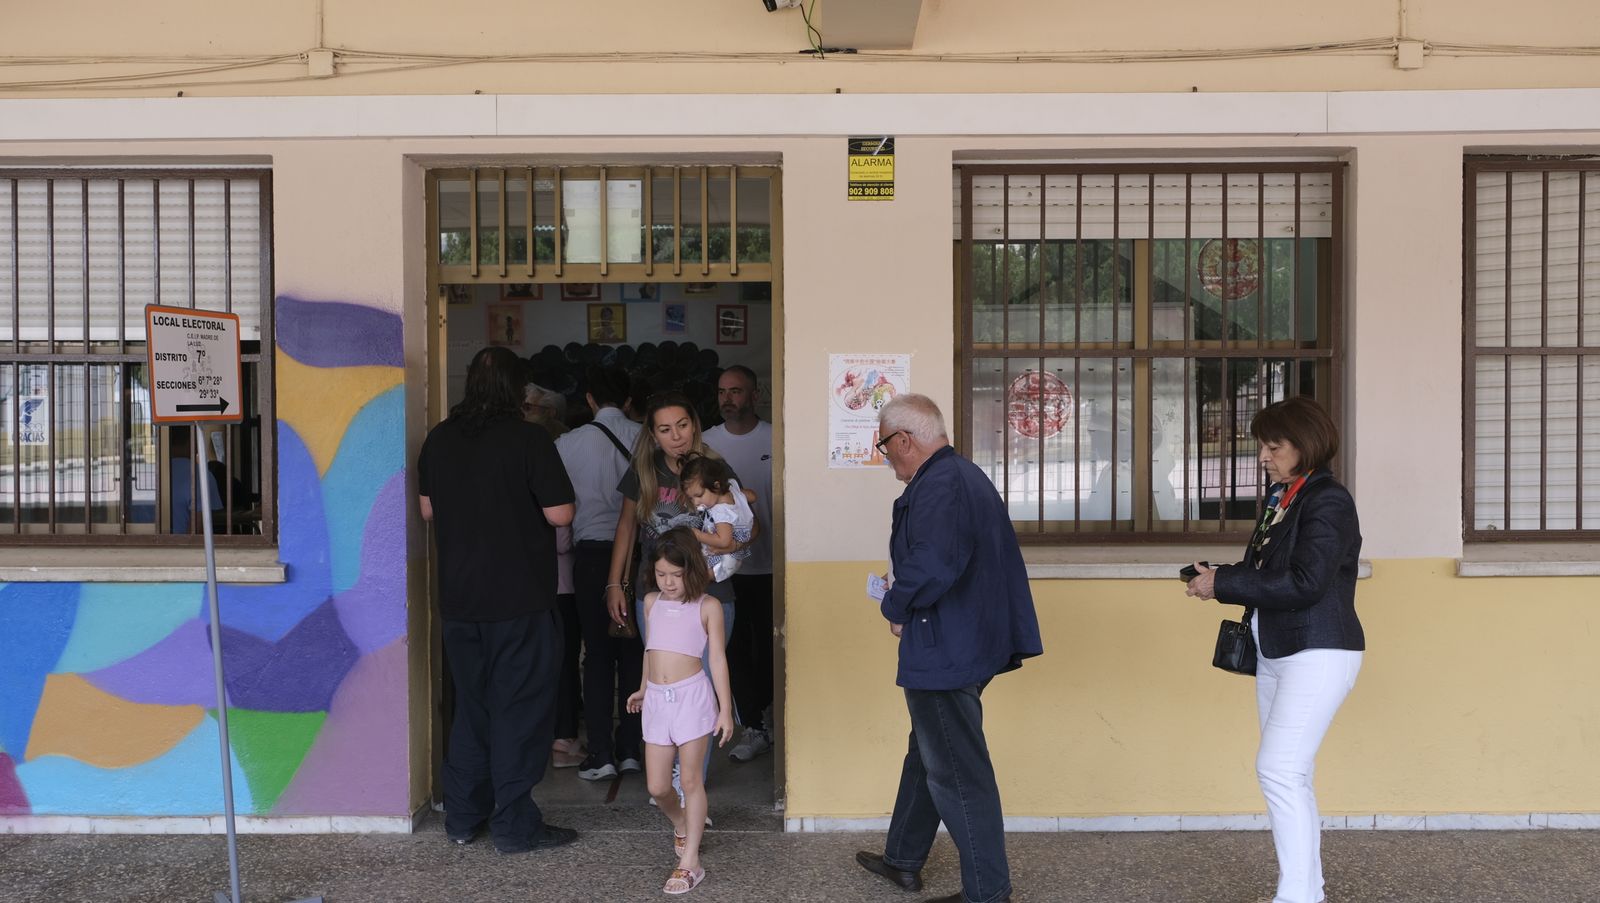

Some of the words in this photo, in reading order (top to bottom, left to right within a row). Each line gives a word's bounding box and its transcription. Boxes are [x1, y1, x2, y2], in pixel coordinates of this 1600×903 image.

[851, 158, 892, 167] ALARMA
[849, 187, 863, 195] 902
[864, 187, 878, 195] 909
[880, 187, 894, 195] 808
[153, 316, 180, 327] LOCAL
[182, 318, 226, 331] ELECTORAL
[155, 352, 187, 362] DISTRITO
[156, 381, 197, 389] SECCIONES
[12, 432, 45, 443] RACIAS
